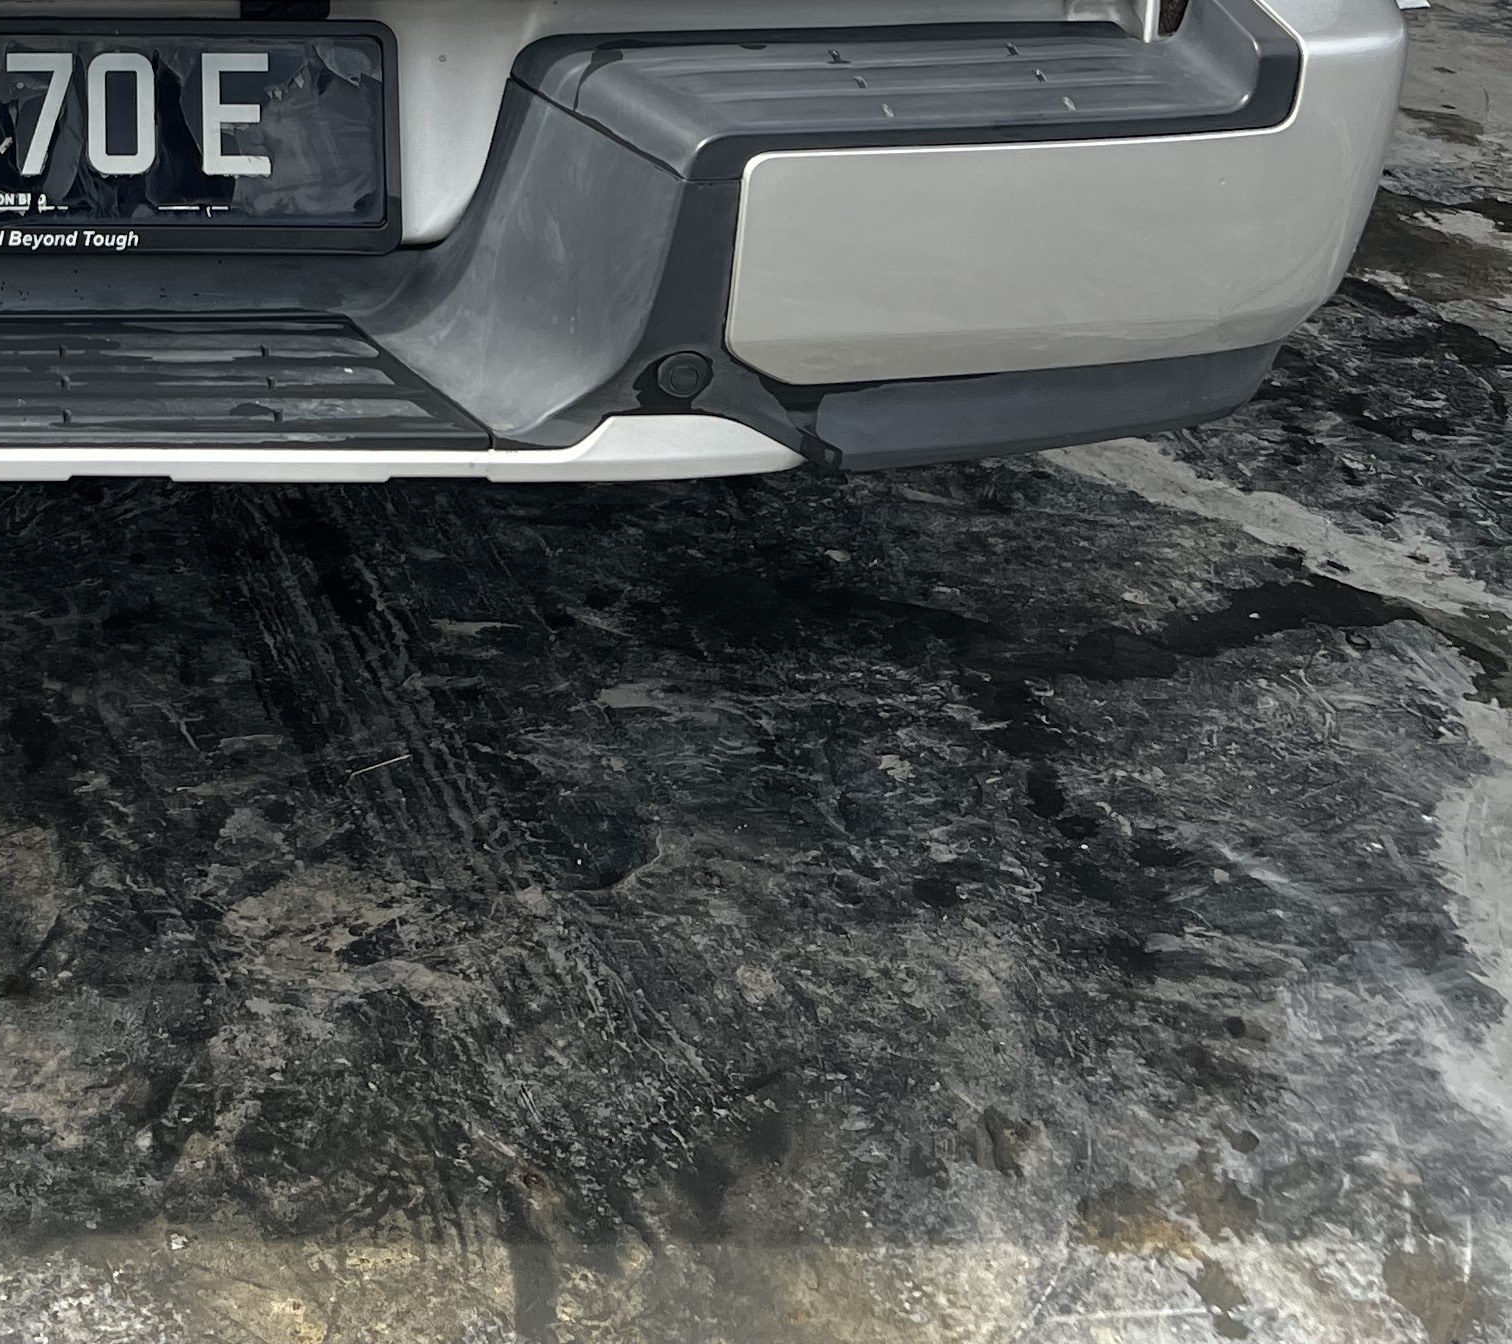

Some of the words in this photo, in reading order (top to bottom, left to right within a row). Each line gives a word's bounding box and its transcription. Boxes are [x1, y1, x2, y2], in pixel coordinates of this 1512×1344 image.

[201, 51, 272, 178] E
[8, 231, 78, 250] Beyond
[82, 230, 140, 250] Tough
